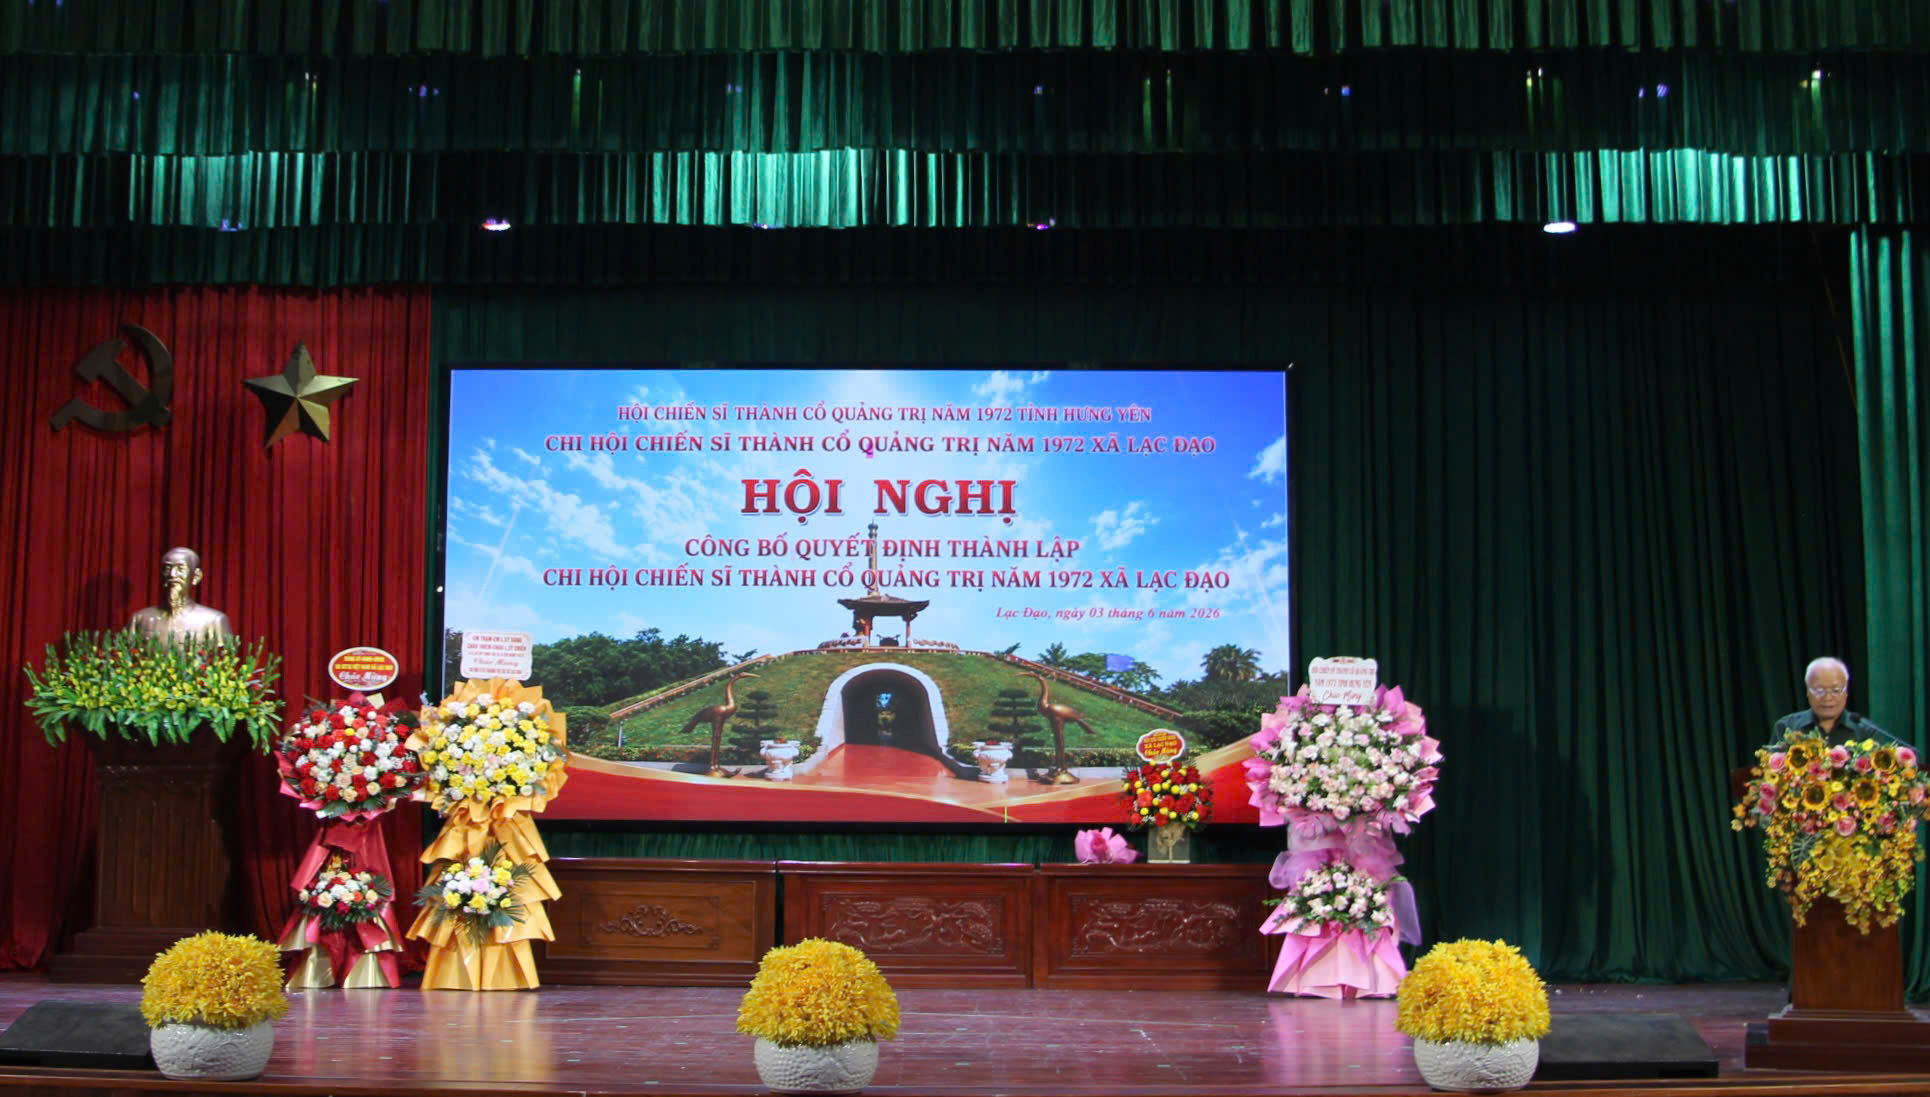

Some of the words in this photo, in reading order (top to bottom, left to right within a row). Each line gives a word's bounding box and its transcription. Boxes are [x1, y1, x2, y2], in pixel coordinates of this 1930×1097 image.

[618, 404, 648, 423] HỘI
[654, 402, 706, 421] CHIẾN
[712, 404, 727, 421] SĨ
[735, 402, 797, 421] THÀNH
[803, 401, 827, 421] CỔ
[832, 401, 893, 423] QUẢNG
[899, 407, 926, 423] TRỊ
[932, 404, 970, 421] NĂM
[977, 407, 1012, 421] 1972
[1018, 403, 1057, 421] TỈNH
[1064, 407, 1112, 421] HƯNG
[1117, 404, 1152, 421] YÊN
[545, 436, 582, 451] CHI
[591, 432, 628, 455] HỘI
[635, 430, 702, 451] CHIẾN
[711, 433, 731, 451] SĨ
[739, 433, 814, 452] THÀNH
[822, 430, 851, 452] CỔ
[859, 431, 935, 456] QUẢNG
[942, 437, 979, 456] TRỊ
[987, 434, 1034, 452] NĂM
[1042, 437, 1085, 452] 1972
[1092, 433, 1120, 452] XÃ
[1128, 438, 1167, 456] LẠC
[1175, 437, 1216, 457] ĐẠO
[740, 468, 844, 525] HỘI
[873, 479, 1017, 525] NGHỊ
[685, 534, 750, 557] CÔNG
[757, 533, 788, 557] BỐ
[795, 532, 874, 560] QUYẾT
[883, 539, 940, 562] ĐỊNH
[948, 536, 1029, 558] THÀNH
[1036, 536, 1080, 562] LẬP
[543, 568, 581, 586] CHI
[589, 565, 628, 590] HỘI
[635, 563, 703, 586] CHIẾN
[711, 566, 731, 586] SĨ
[738, 565, 815, 587] THÀNH
[823, 563, 854, 587] CỔ
[861, 564, 941, 591] QUẢNG
[948, 570, 984, 592] TRỊ
[991, 566, 1041, 588] NĂM
[1049, 571, 1093, 588] 1972
[1100, 566, 1129, 588] XÃ
[1136, 571, 1177, 592] LẠC
[1184, 571, 1230, 592] ĐẠO
